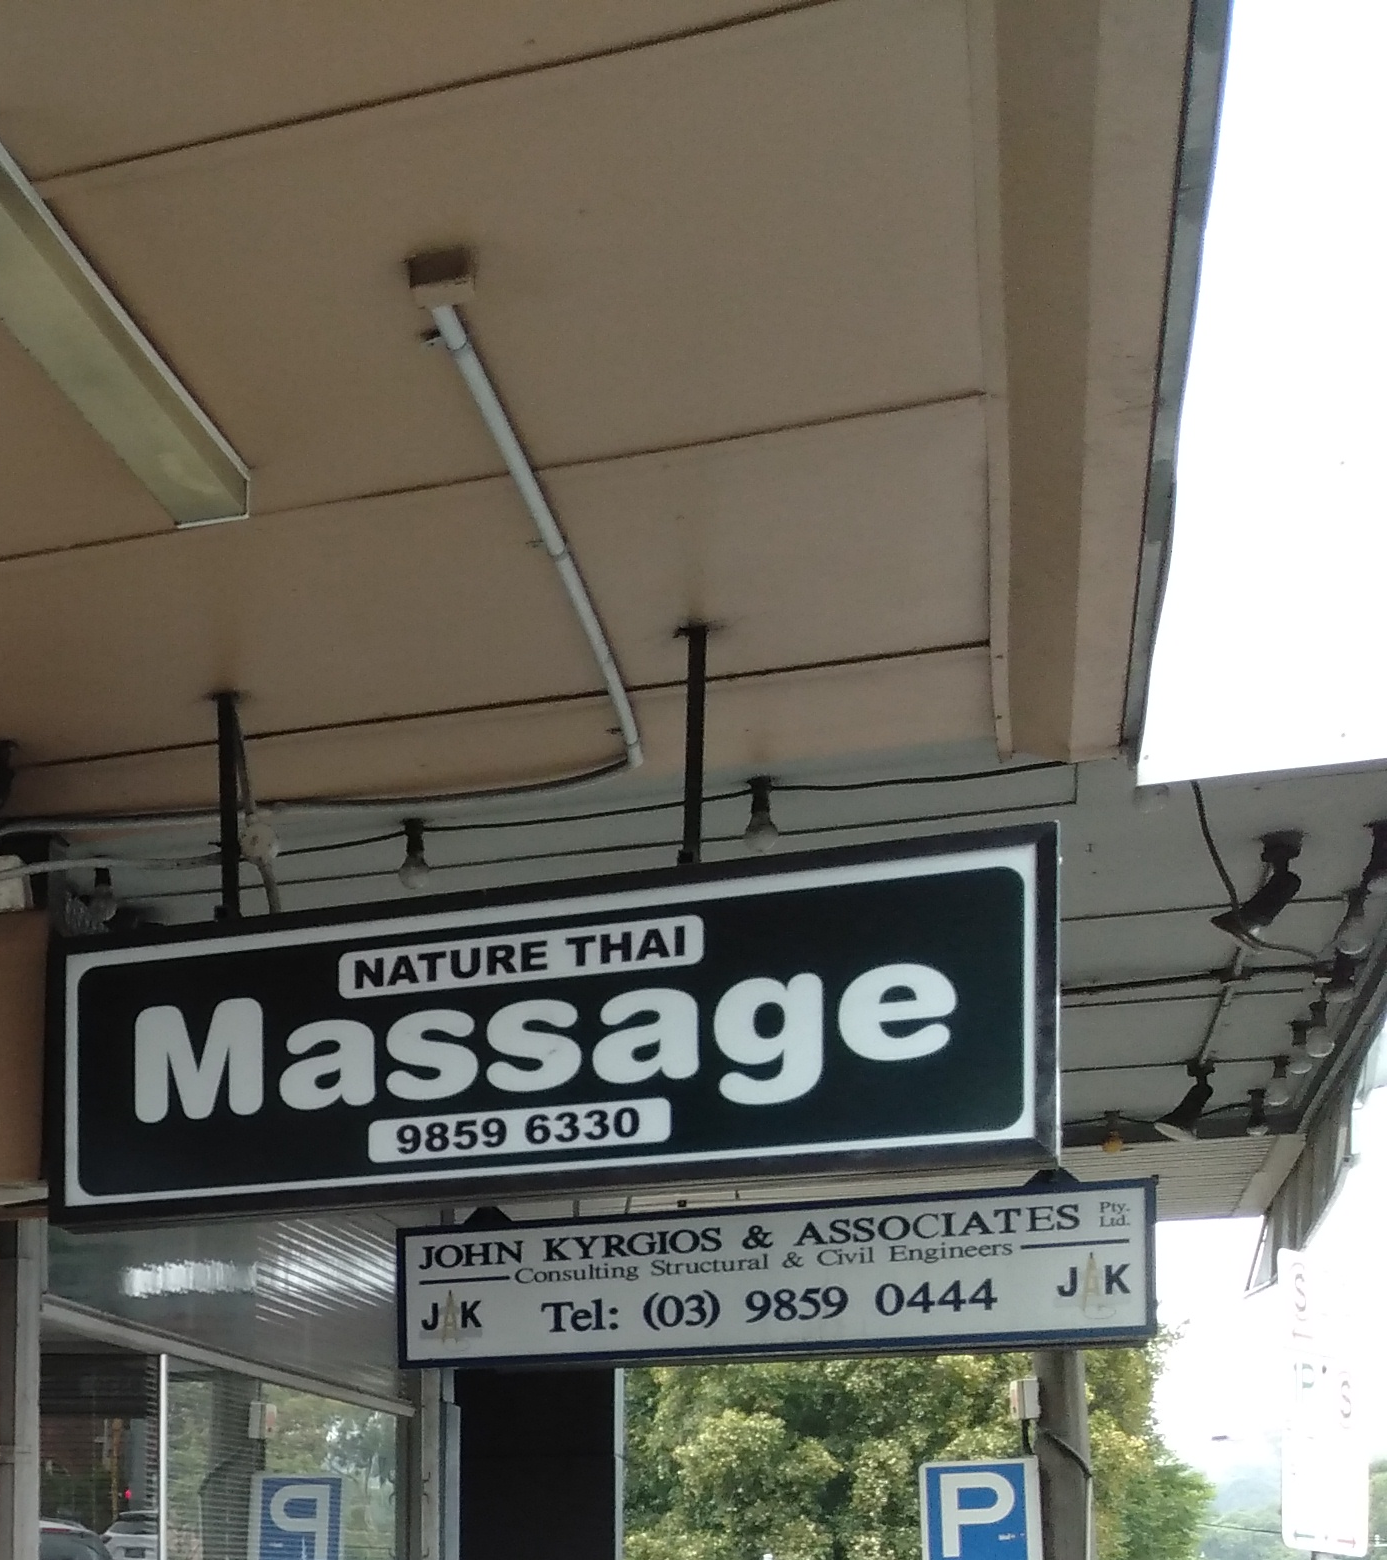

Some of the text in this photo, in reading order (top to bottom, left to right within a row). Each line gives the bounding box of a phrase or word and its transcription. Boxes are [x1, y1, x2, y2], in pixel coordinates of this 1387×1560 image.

[354, 925, 686, 990] NATURE THAI
[135, 963, 958, 1124] Massage
[395, 1106, 641, 1156] 9859 6330
[418, 1240, 524, 1271] JOHN
[542, 1226, 723, 1263] KYRGIOS
[741, 1224, 774, 1250] &
[793, 1203, 1081, 1247] ASSOCIATES
[514, 1242, 1014, 1285] Consulting Structural & Civil Engineers
[540, 1298, 620, 1333] Tel:
[643, 1289, 721, 1331] (03)
[745, 1285, 850, 1324] 9859
[874, 1278, 999, 1317] 0444
[940, 1472, 1015, 1558] P
